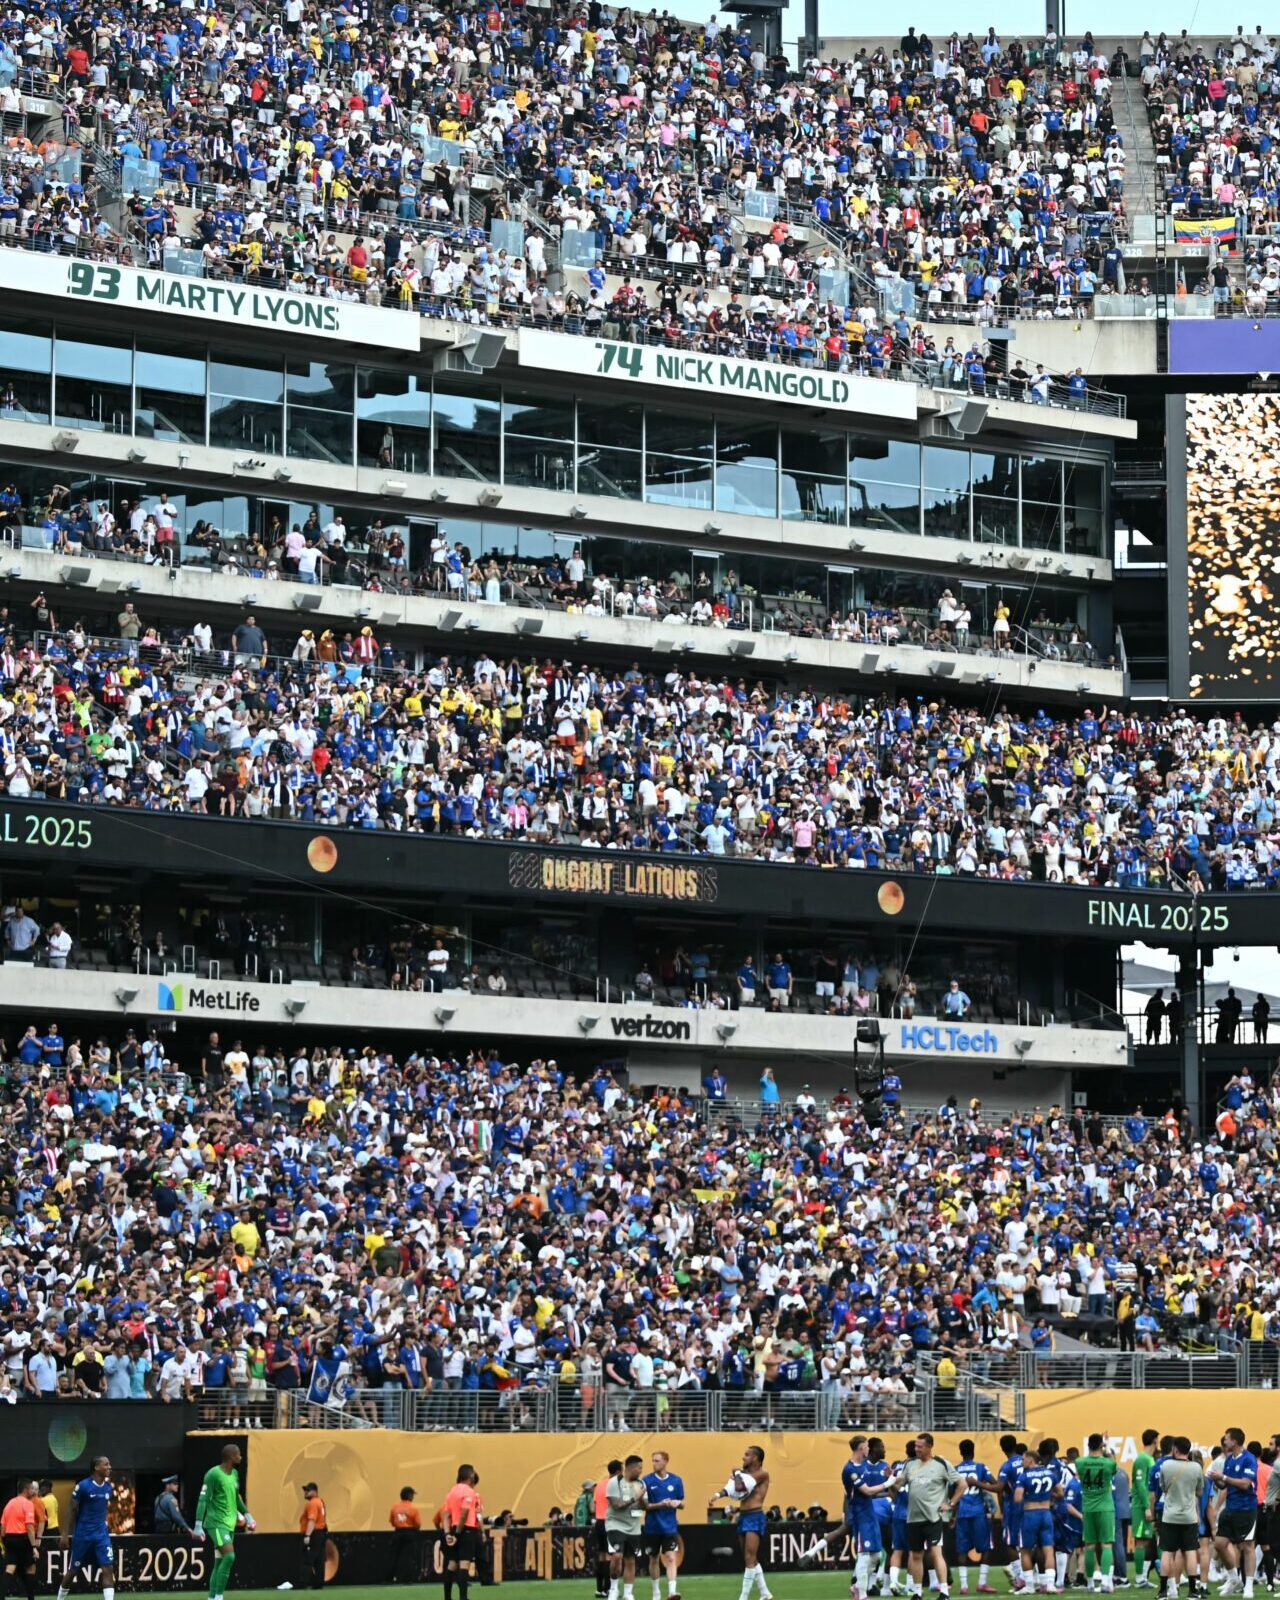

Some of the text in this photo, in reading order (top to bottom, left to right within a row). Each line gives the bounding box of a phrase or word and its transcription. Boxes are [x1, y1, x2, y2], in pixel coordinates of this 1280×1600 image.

[67, 262, 339, 332] 93 MARTY LYONS
[594, 342, 850, 404] 74 NICK MANGOLD
[25, 812, 92, 849] 2025
[1088, 900, 1229, 931] FINAL 2025
[188, 988, 260, 1014] MetLife
[611, 1016, 691, 1041] verizon
[901, 1024, 998, 1054] HCLTech
[1083, 1469, 1104, 1489] 44
[138, 1547, 205, 1581] 2025
